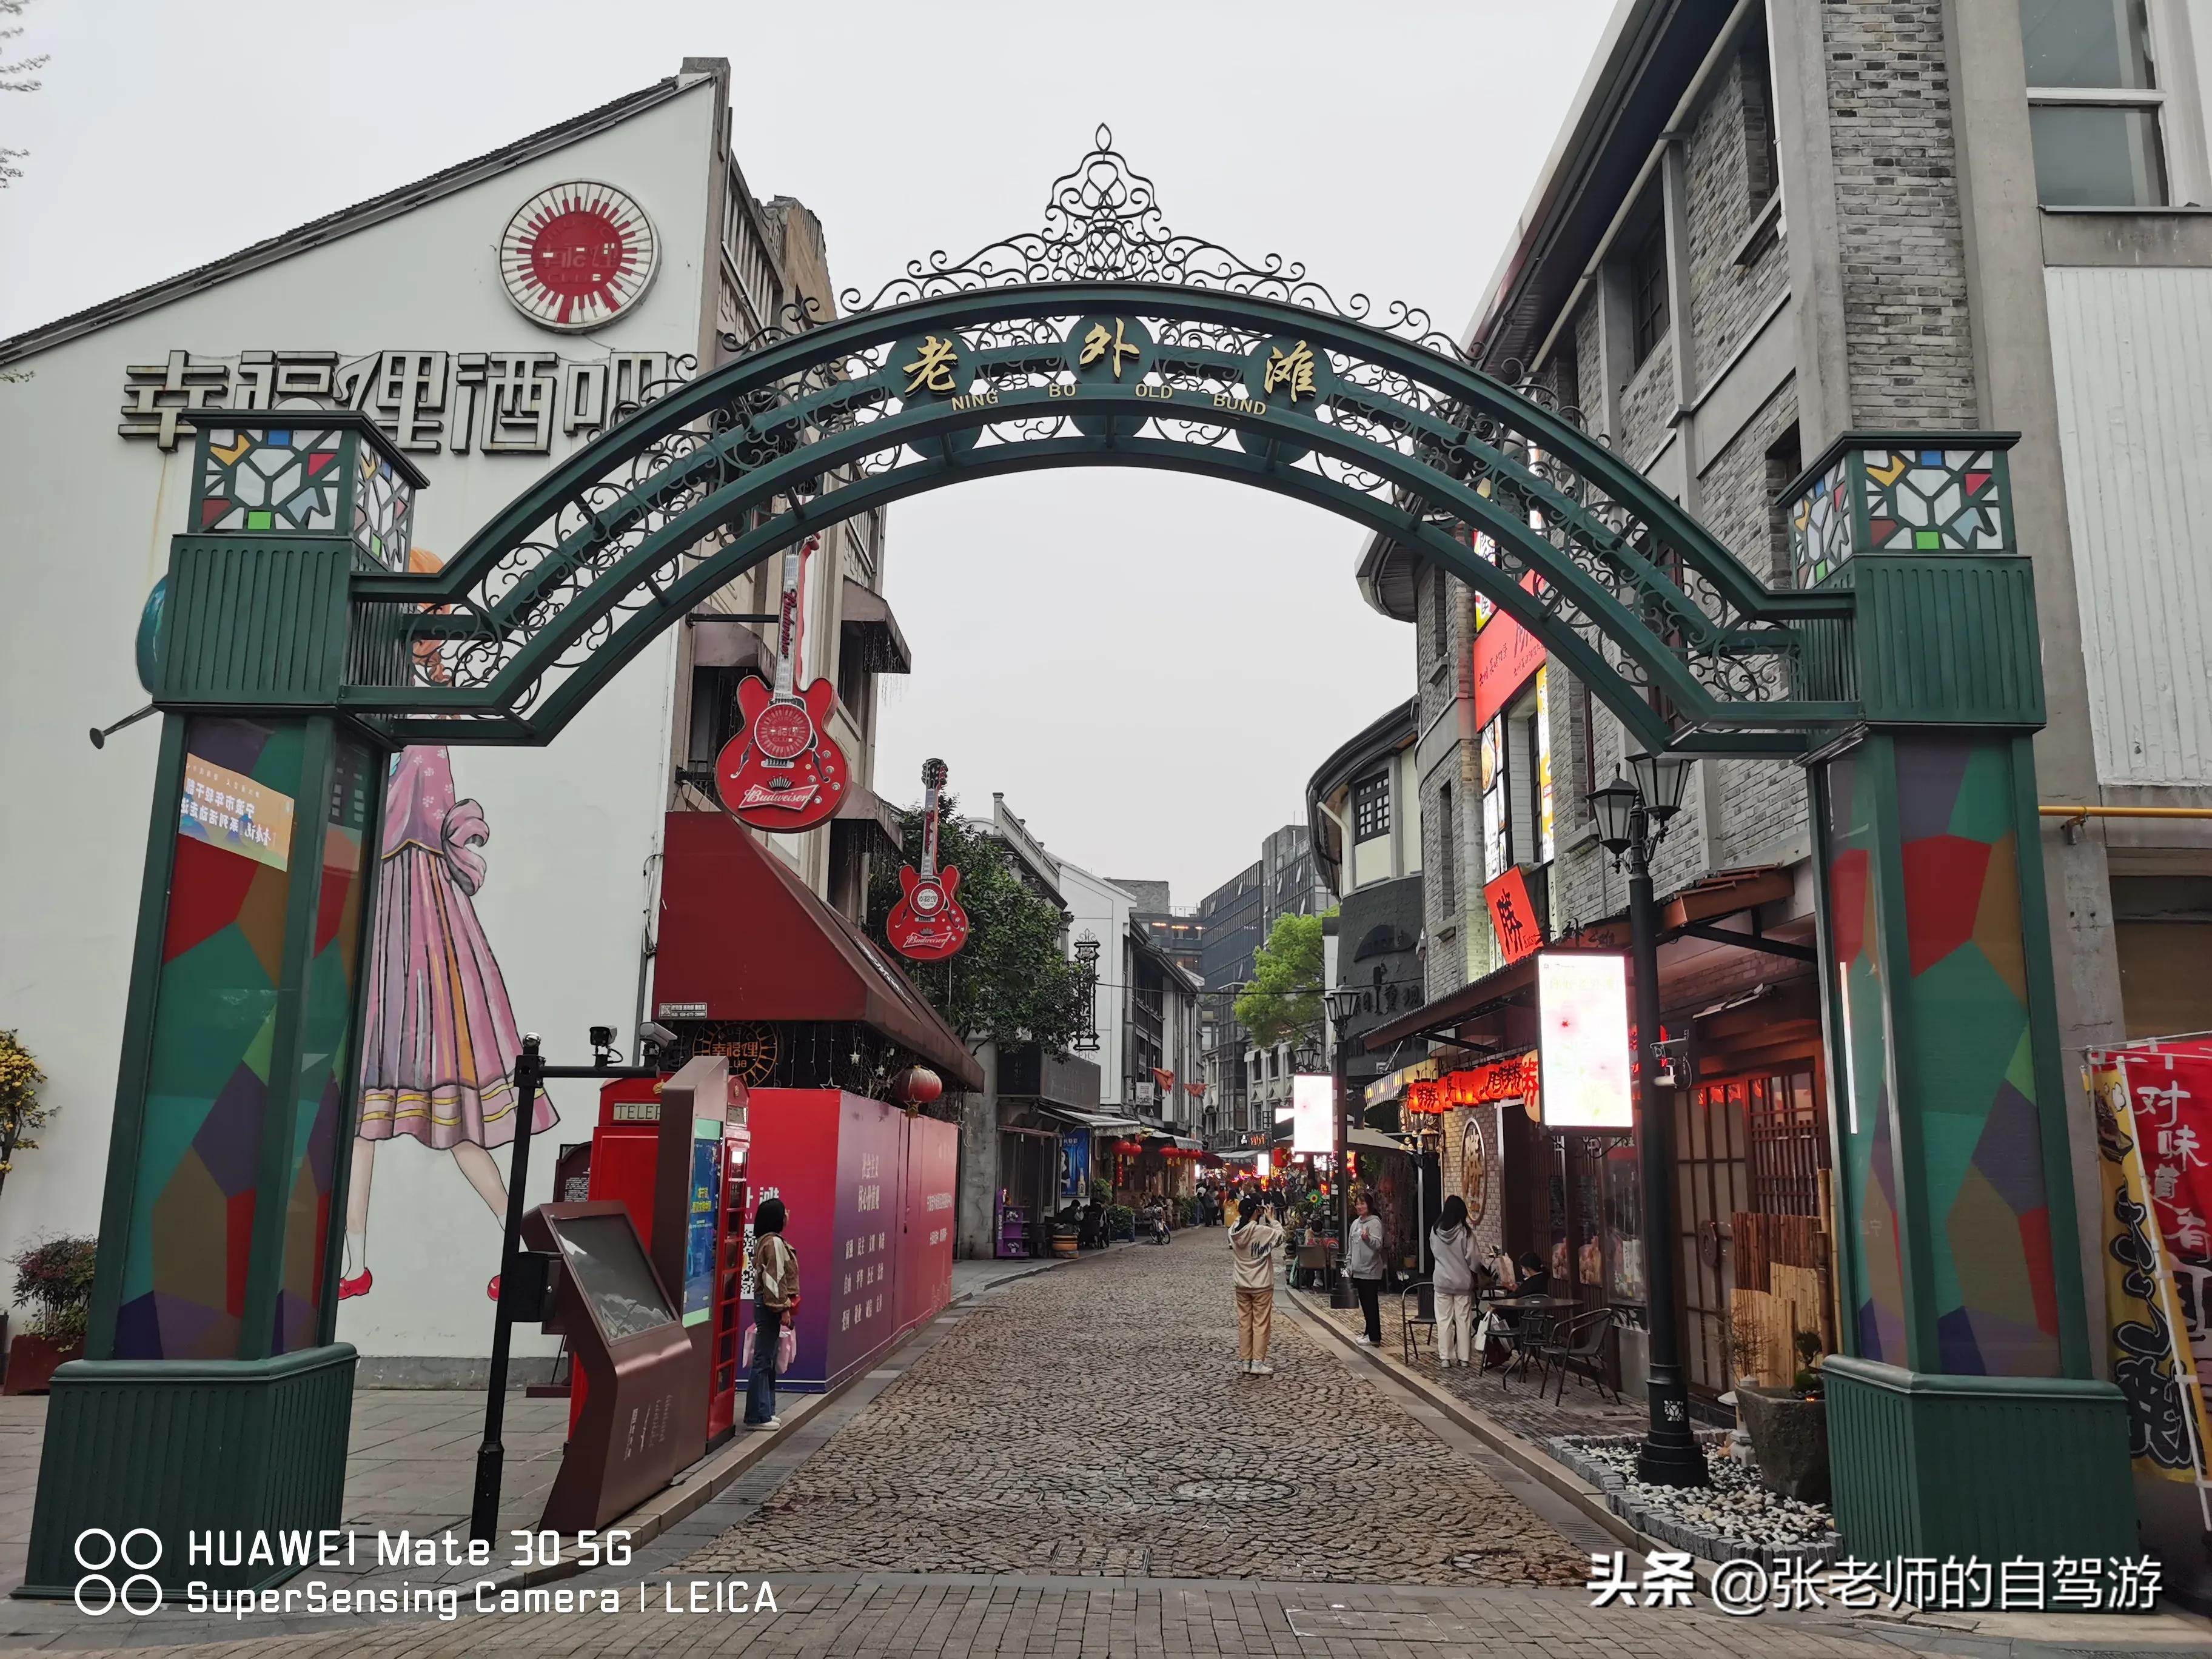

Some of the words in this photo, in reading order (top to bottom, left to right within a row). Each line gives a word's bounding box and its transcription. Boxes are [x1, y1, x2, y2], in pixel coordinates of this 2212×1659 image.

[951, 390, 999, 411] NING
[1048, 383, 1076, 398] BO
[1134, 383, 1173, 400] OLD
[1213, 392, 1267, 417] BUND
[745, 787, 811, 804] Budweiser
[906, 934, 948, 944] Budweiser
[862, 1152, 879, 1179] 社会主义
[858, 1184, 880, 1212] 核心价值观
[845, 1239, 854, 1260] 富强
[857, 1235, 865, 1256] 民主
[843, 1273, 851, 1295] 自由
[856, 1269, 863, 1290] 平等
